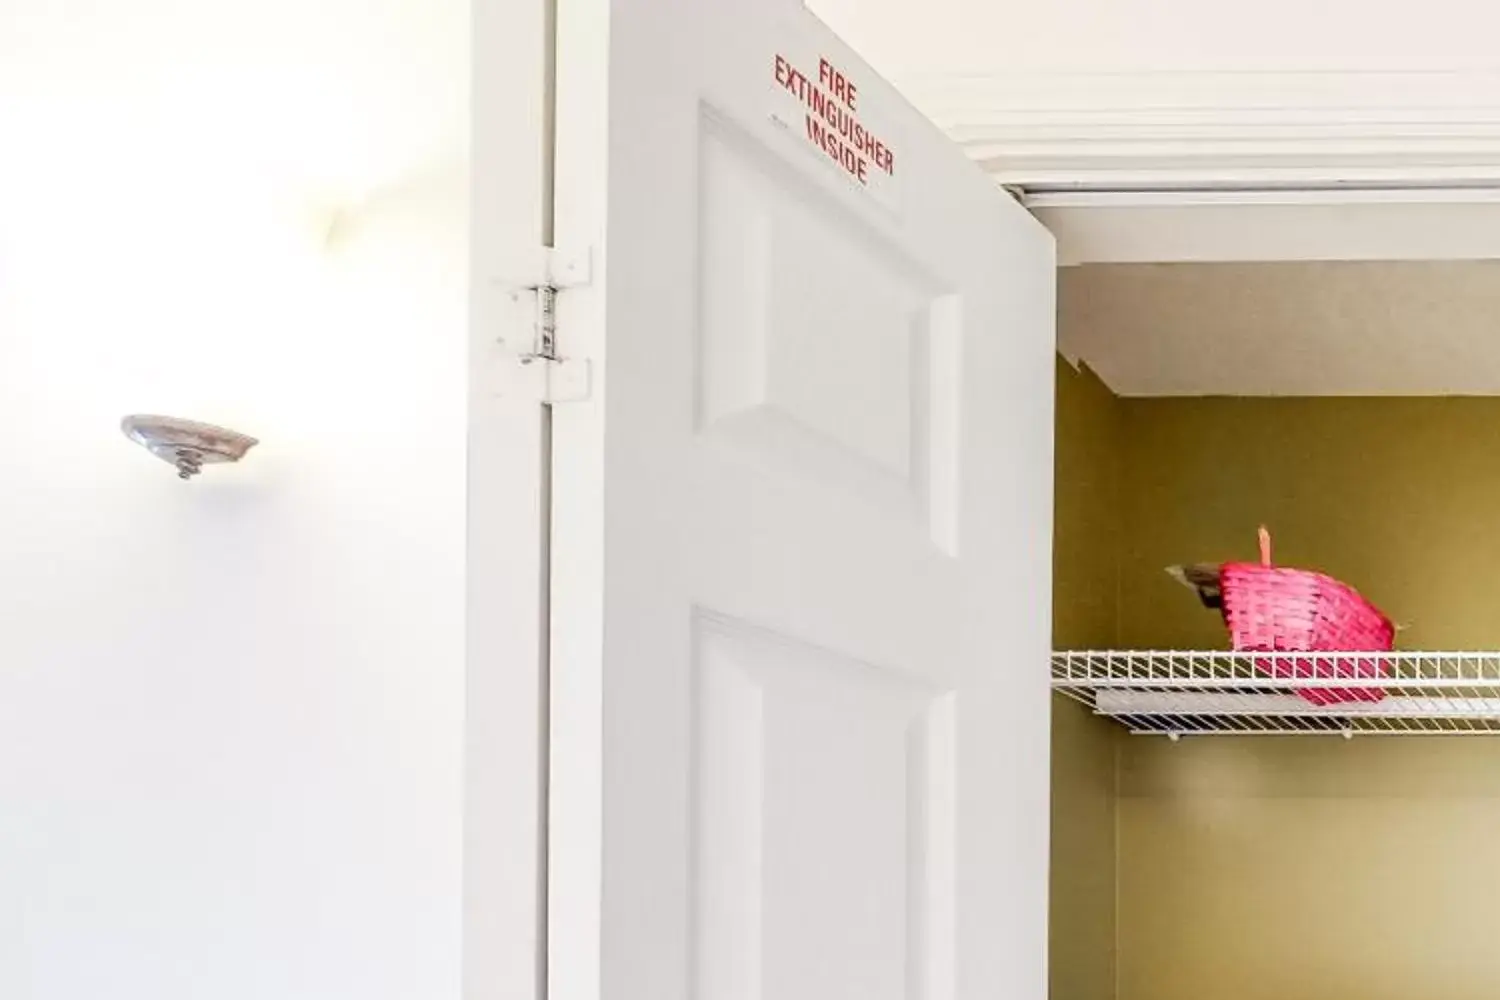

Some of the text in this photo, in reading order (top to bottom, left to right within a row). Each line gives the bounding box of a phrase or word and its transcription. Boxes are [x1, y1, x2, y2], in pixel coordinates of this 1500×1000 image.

[775, 54, 894, 176] EXTINGUISHER
[819, 57, 857, 112] FIRE
[806, 114, 867, 186] INSIDE
